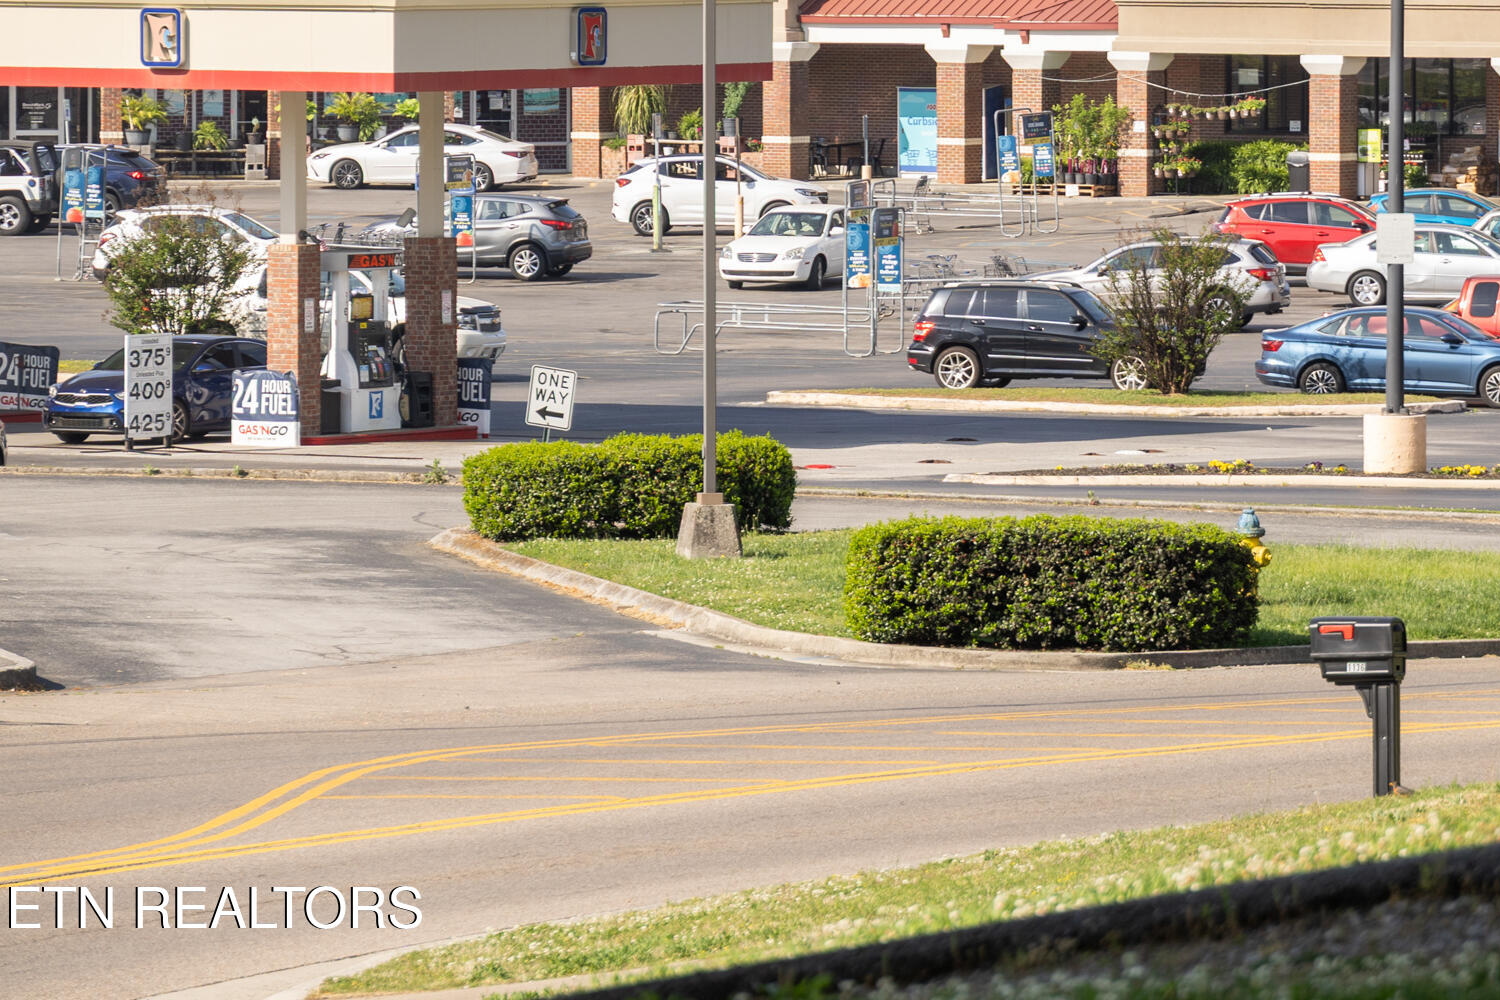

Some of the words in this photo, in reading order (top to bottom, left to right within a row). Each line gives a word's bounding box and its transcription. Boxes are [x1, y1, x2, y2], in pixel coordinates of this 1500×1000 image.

[23, 354, 51, 369] HOUR
[22, 368, 51, 389] FUEL
[538, 371, 570, 389] ONE
[232, 378, 259, 415] 24
[261, 379, 291, 394] HOUR
[260, 393, 296, 415] FUEL
[536, 388, 569, 405] WAY
